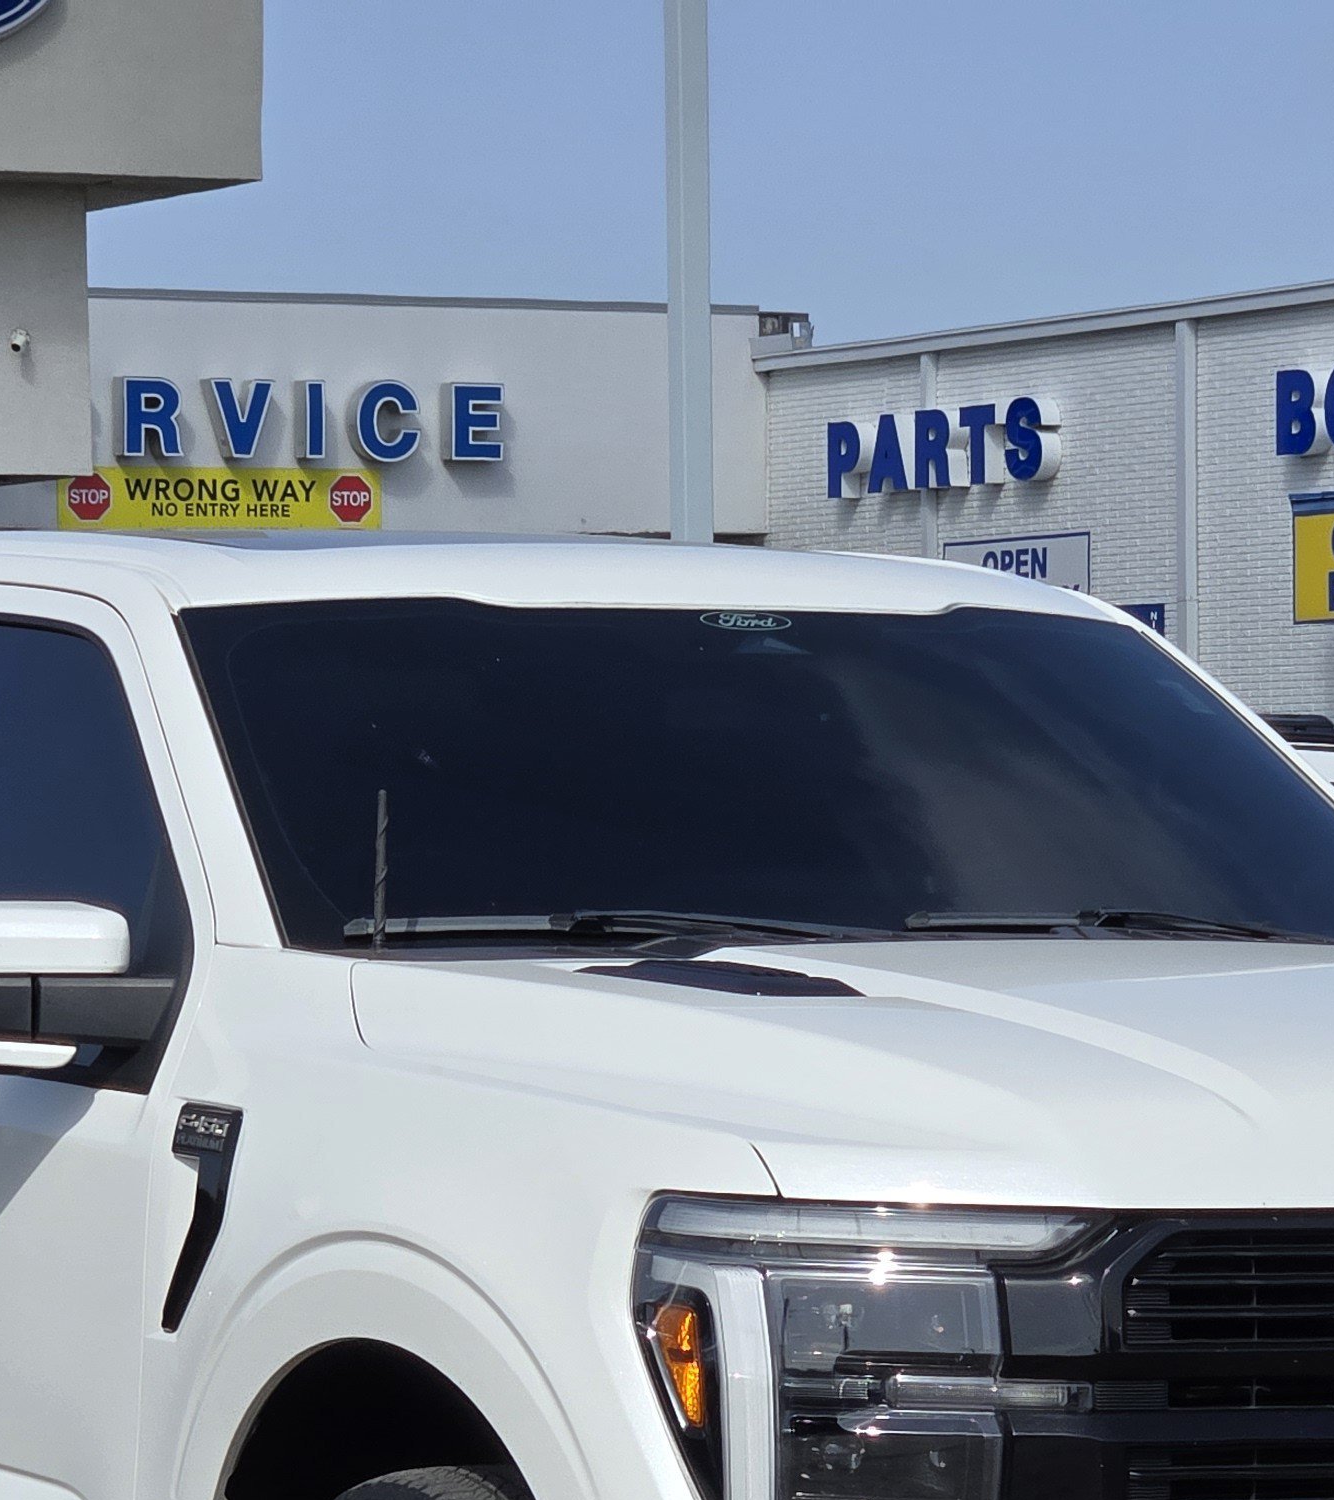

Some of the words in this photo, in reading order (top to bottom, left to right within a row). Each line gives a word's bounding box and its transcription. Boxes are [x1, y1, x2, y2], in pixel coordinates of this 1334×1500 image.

[827, 397, 1043, 498] PARTS
[70, 489, 109, 504] STOP
[124, 478, 240, 502] WRONG
[251, 479, 316, 503] WAY
[332, 490, 370, 506] STOP
[151, 503, 178, 517] NO
[185, 503, 240, 518] ENTRY
[246, 504, 291, 518] HERE
[718, 612, 777, 627] Ford
